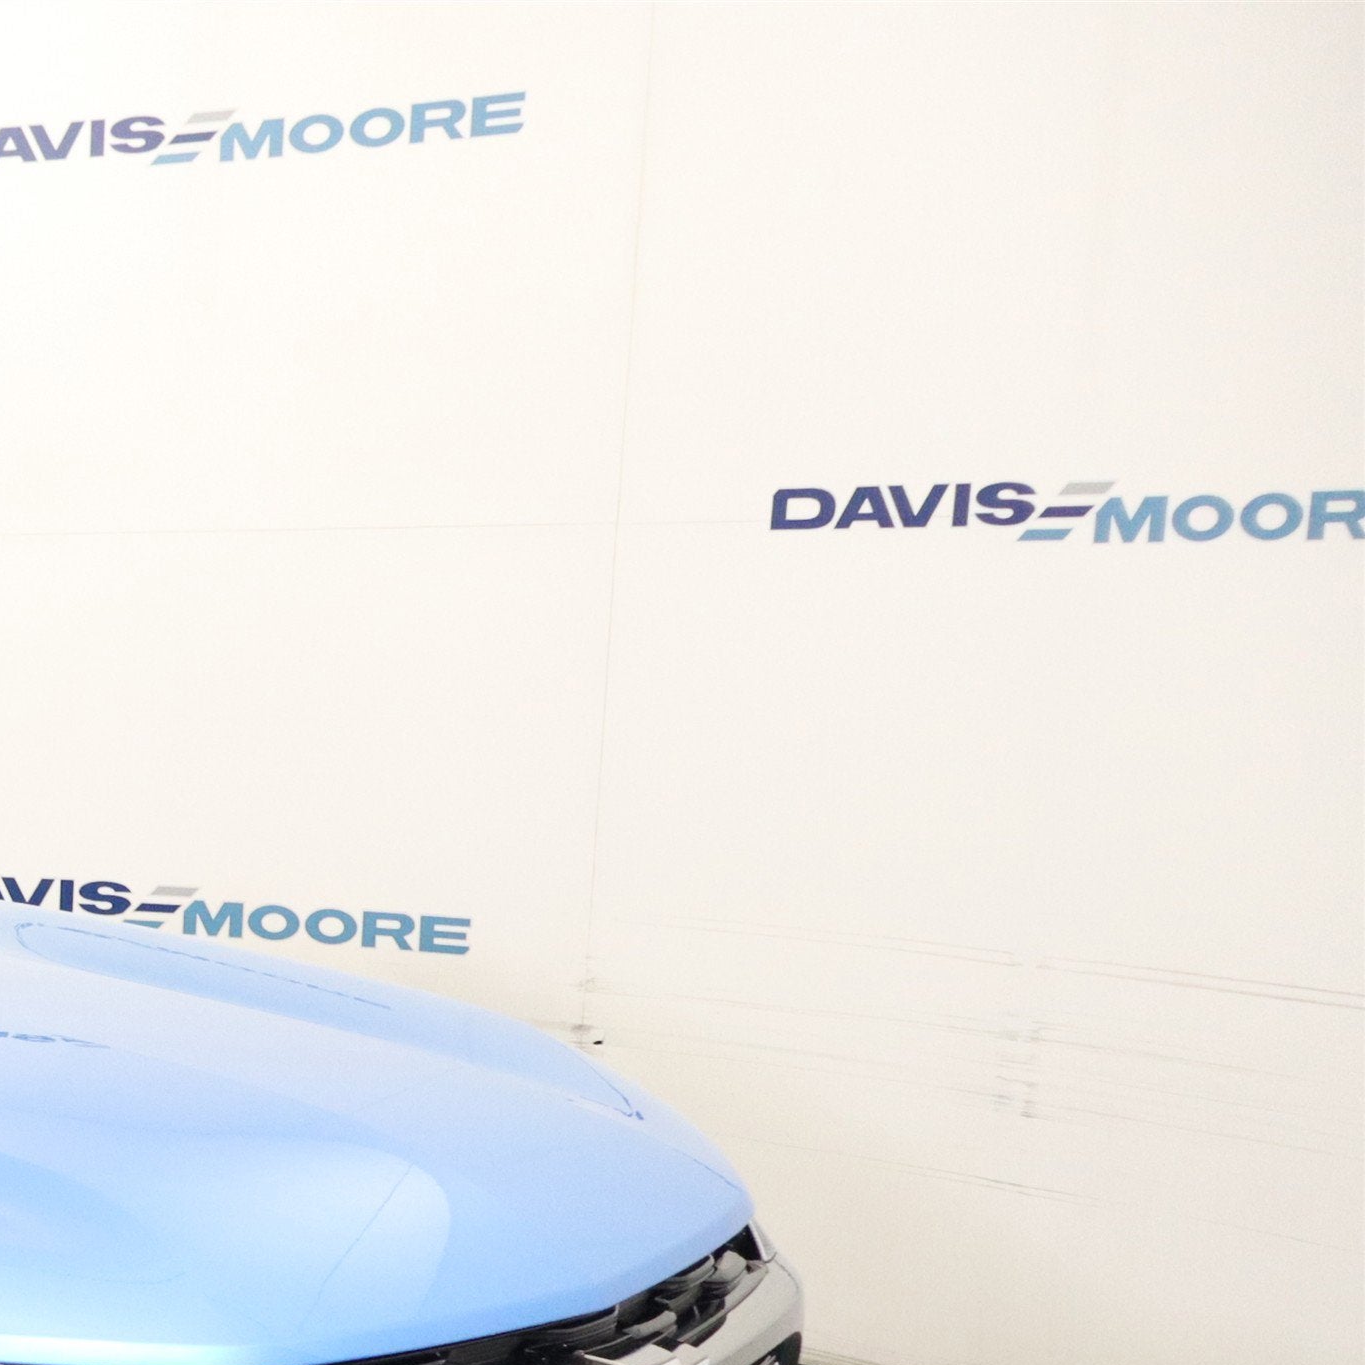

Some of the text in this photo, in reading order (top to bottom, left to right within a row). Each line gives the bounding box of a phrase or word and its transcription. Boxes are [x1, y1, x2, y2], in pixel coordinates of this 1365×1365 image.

[220, 91, 526, 163] MOORE
[770, 482, 1035, 530] DAVIS
[182, 900, 471, 955] MOORE
